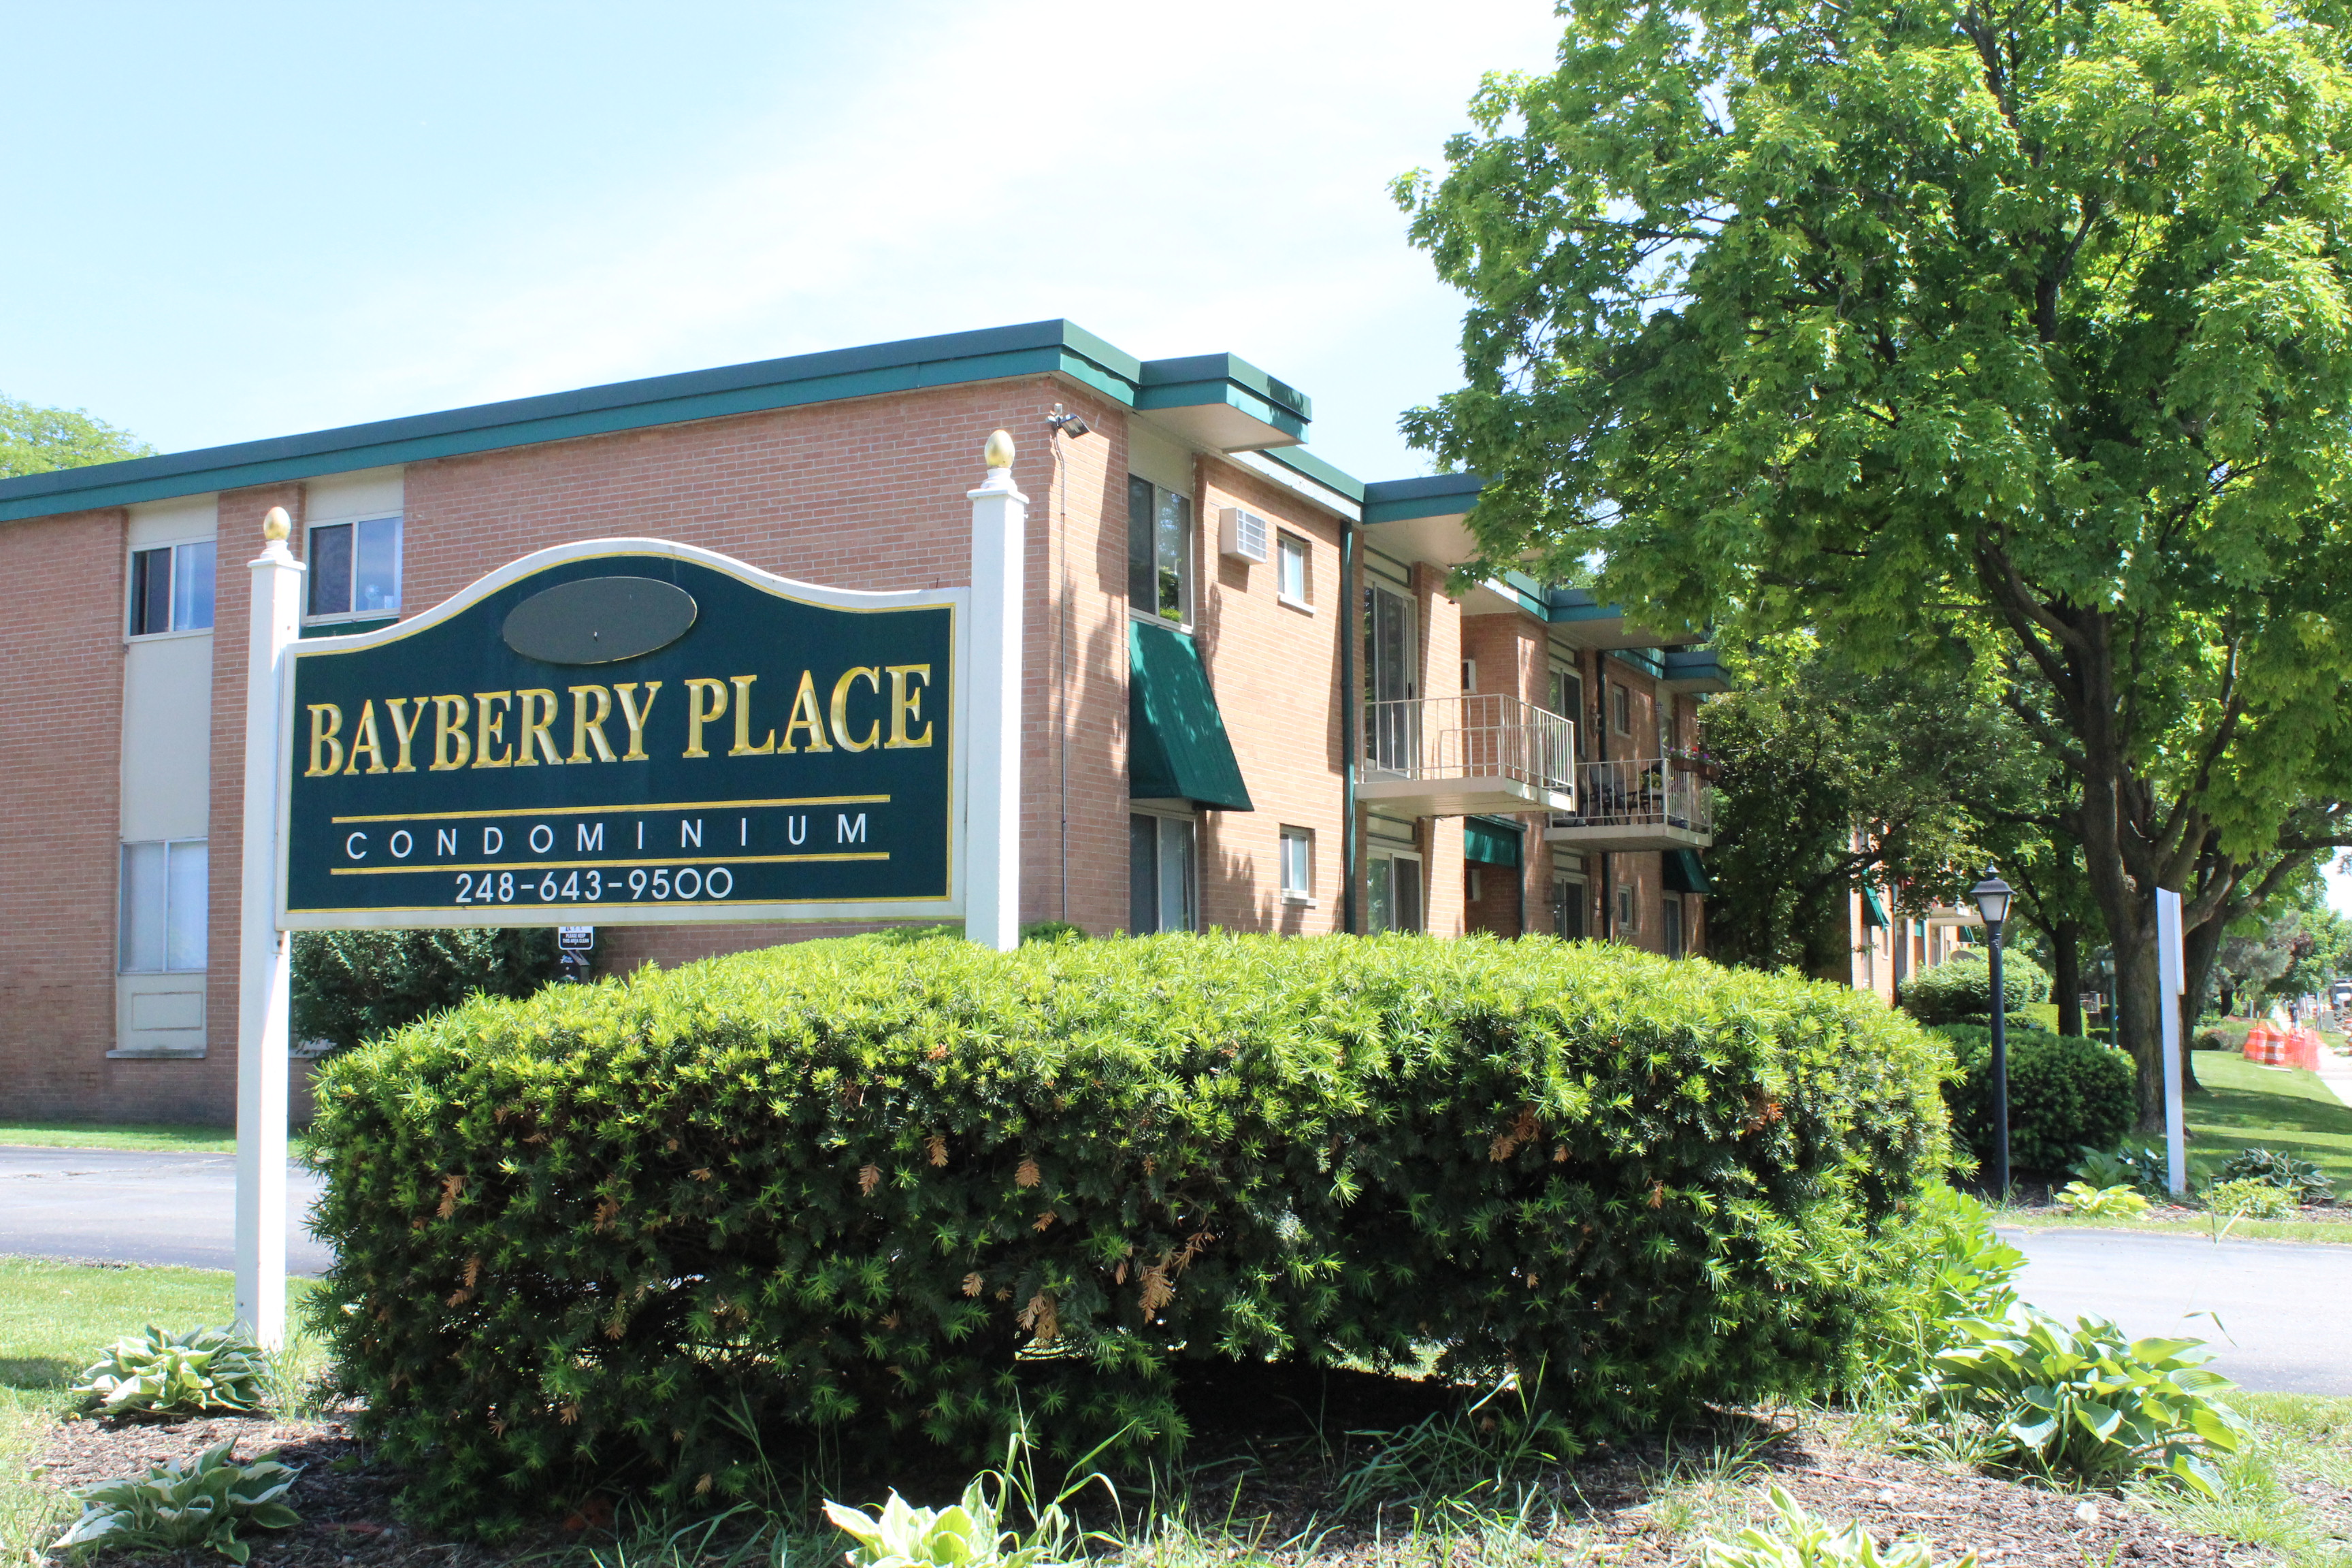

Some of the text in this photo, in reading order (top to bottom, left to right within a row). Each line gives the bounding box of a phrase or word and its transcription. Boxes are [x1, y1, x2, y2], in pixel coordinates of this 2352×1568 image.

[304, 663, 934, 778] BAYBERRY PLACE
[346, 813, 866, 860] CONDOMINIUM
[455, 867, 734, 903] 248-643-9500
